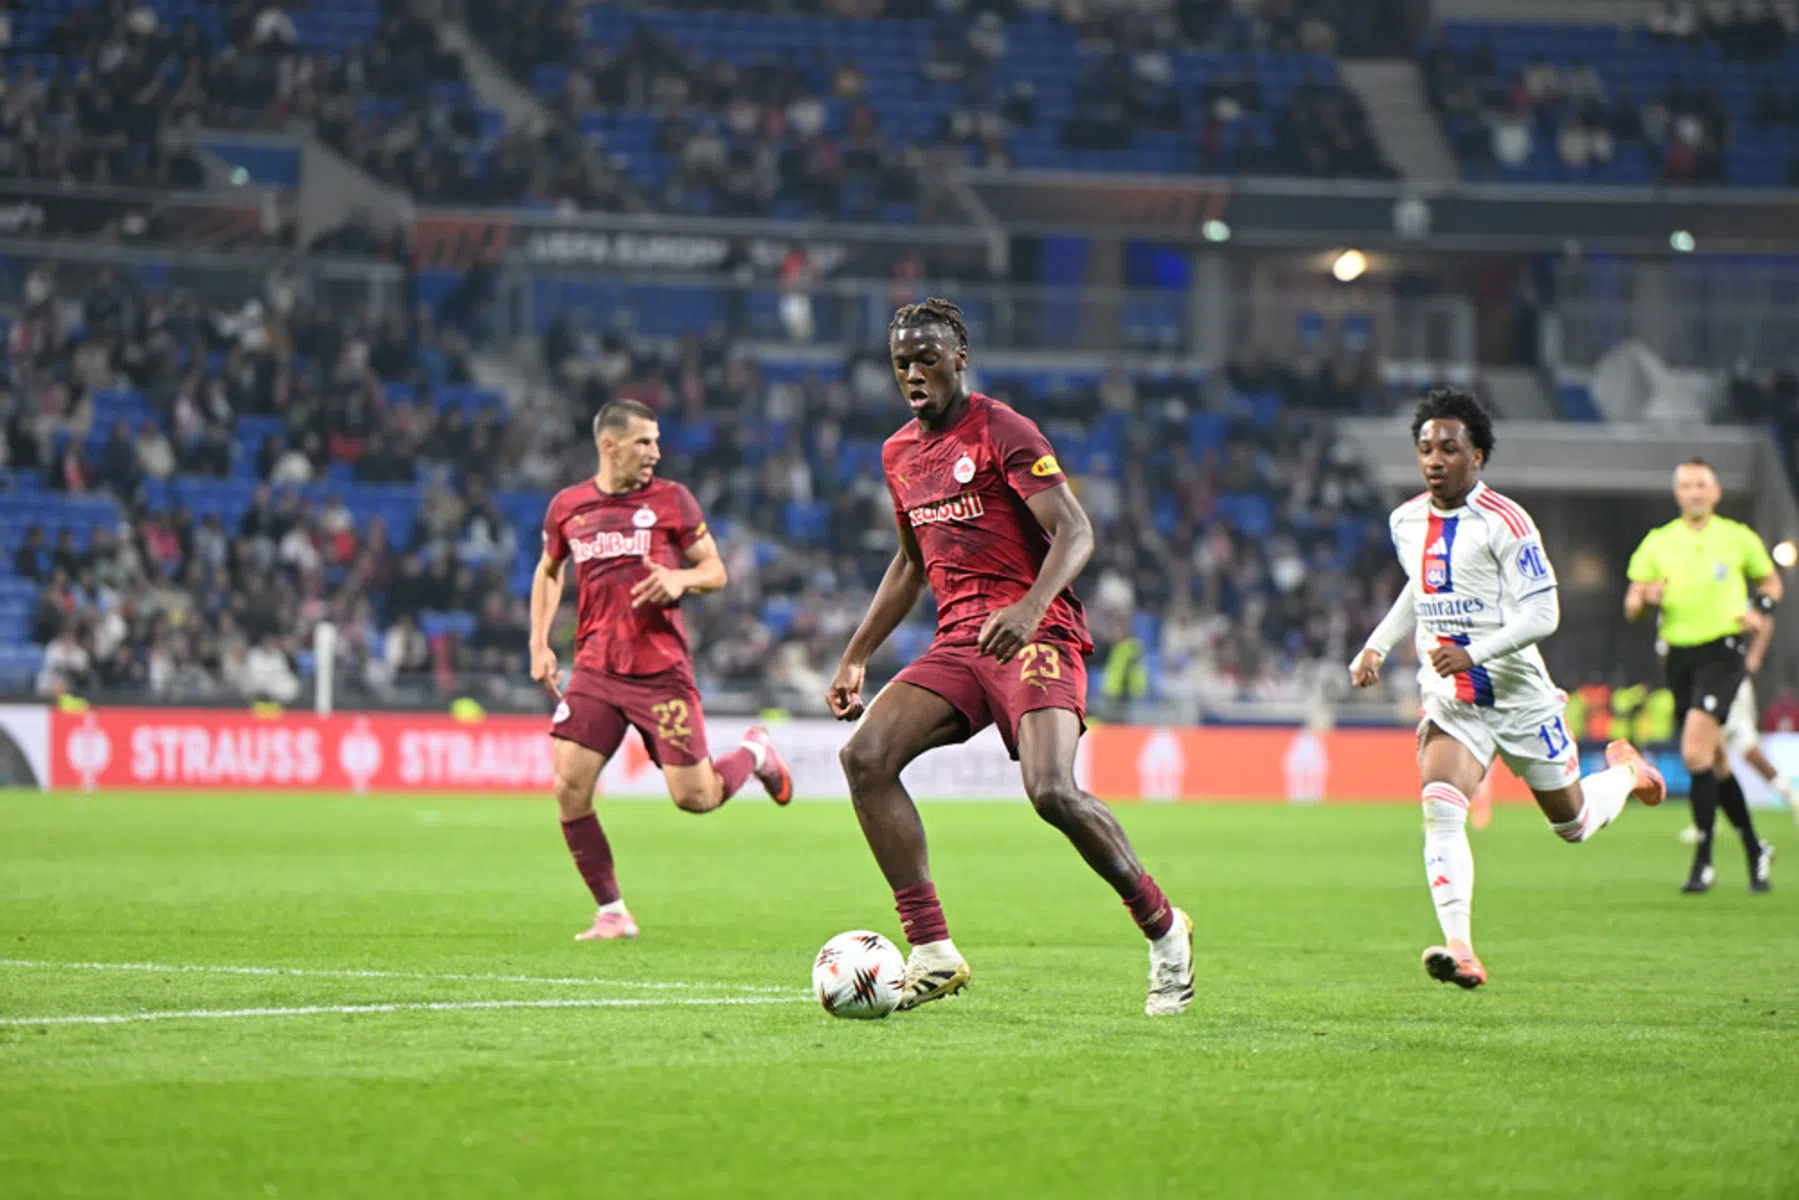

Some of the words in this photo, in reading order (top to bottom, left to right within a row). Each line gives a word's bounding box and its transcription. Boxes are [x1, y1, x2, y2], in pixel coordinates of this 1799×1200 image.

[1019, 644, 1060, 681] 23
[652, 699, 691, 739] 22
[131, 725, 322, 783] STRAUSS
[398, 729, 555, 784] STRAUS
